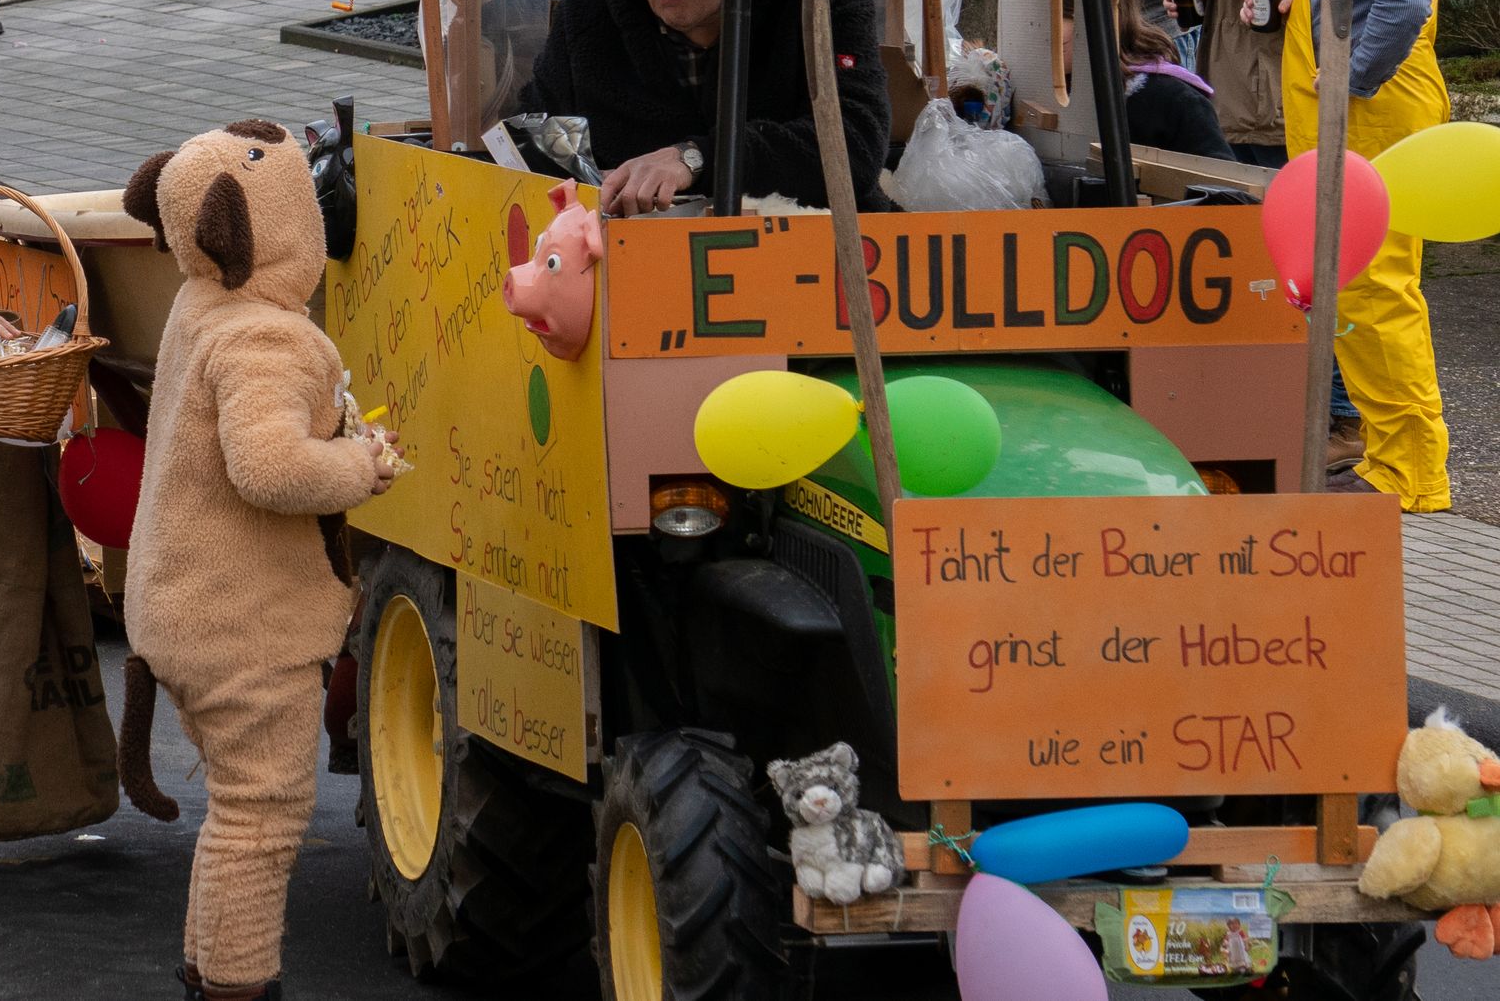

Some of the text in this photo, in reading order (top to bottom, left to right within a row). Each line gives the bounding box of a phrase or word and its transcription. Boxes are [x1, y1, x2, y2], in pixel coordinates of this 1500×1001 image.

[334, 278, 361, 338] Den
[359, 217, 404, 303] Bauern
[388, 298, 413, 355] den
[417, 206, 461, 302] SACK
[434, 230, 504, 366] Ampelpack
[449, 426, 472, 486] Sie
[536, 469, 572, 529] nicht
[449, 501, 474, 566] Sie
[538, 545, 572, 609] nicht
[912, 526, 1367, 586] Fährt der Bauer mit Solar
[462, 585, 581, 686] Aber sie wissen
[968, 615, 1328, 694] grinst der Habeck
[477, 677, 567, 762] alles besser
[1028, 711, 1302, 774] wie ein STAR
[1168, 921, 1188, 936] 10
